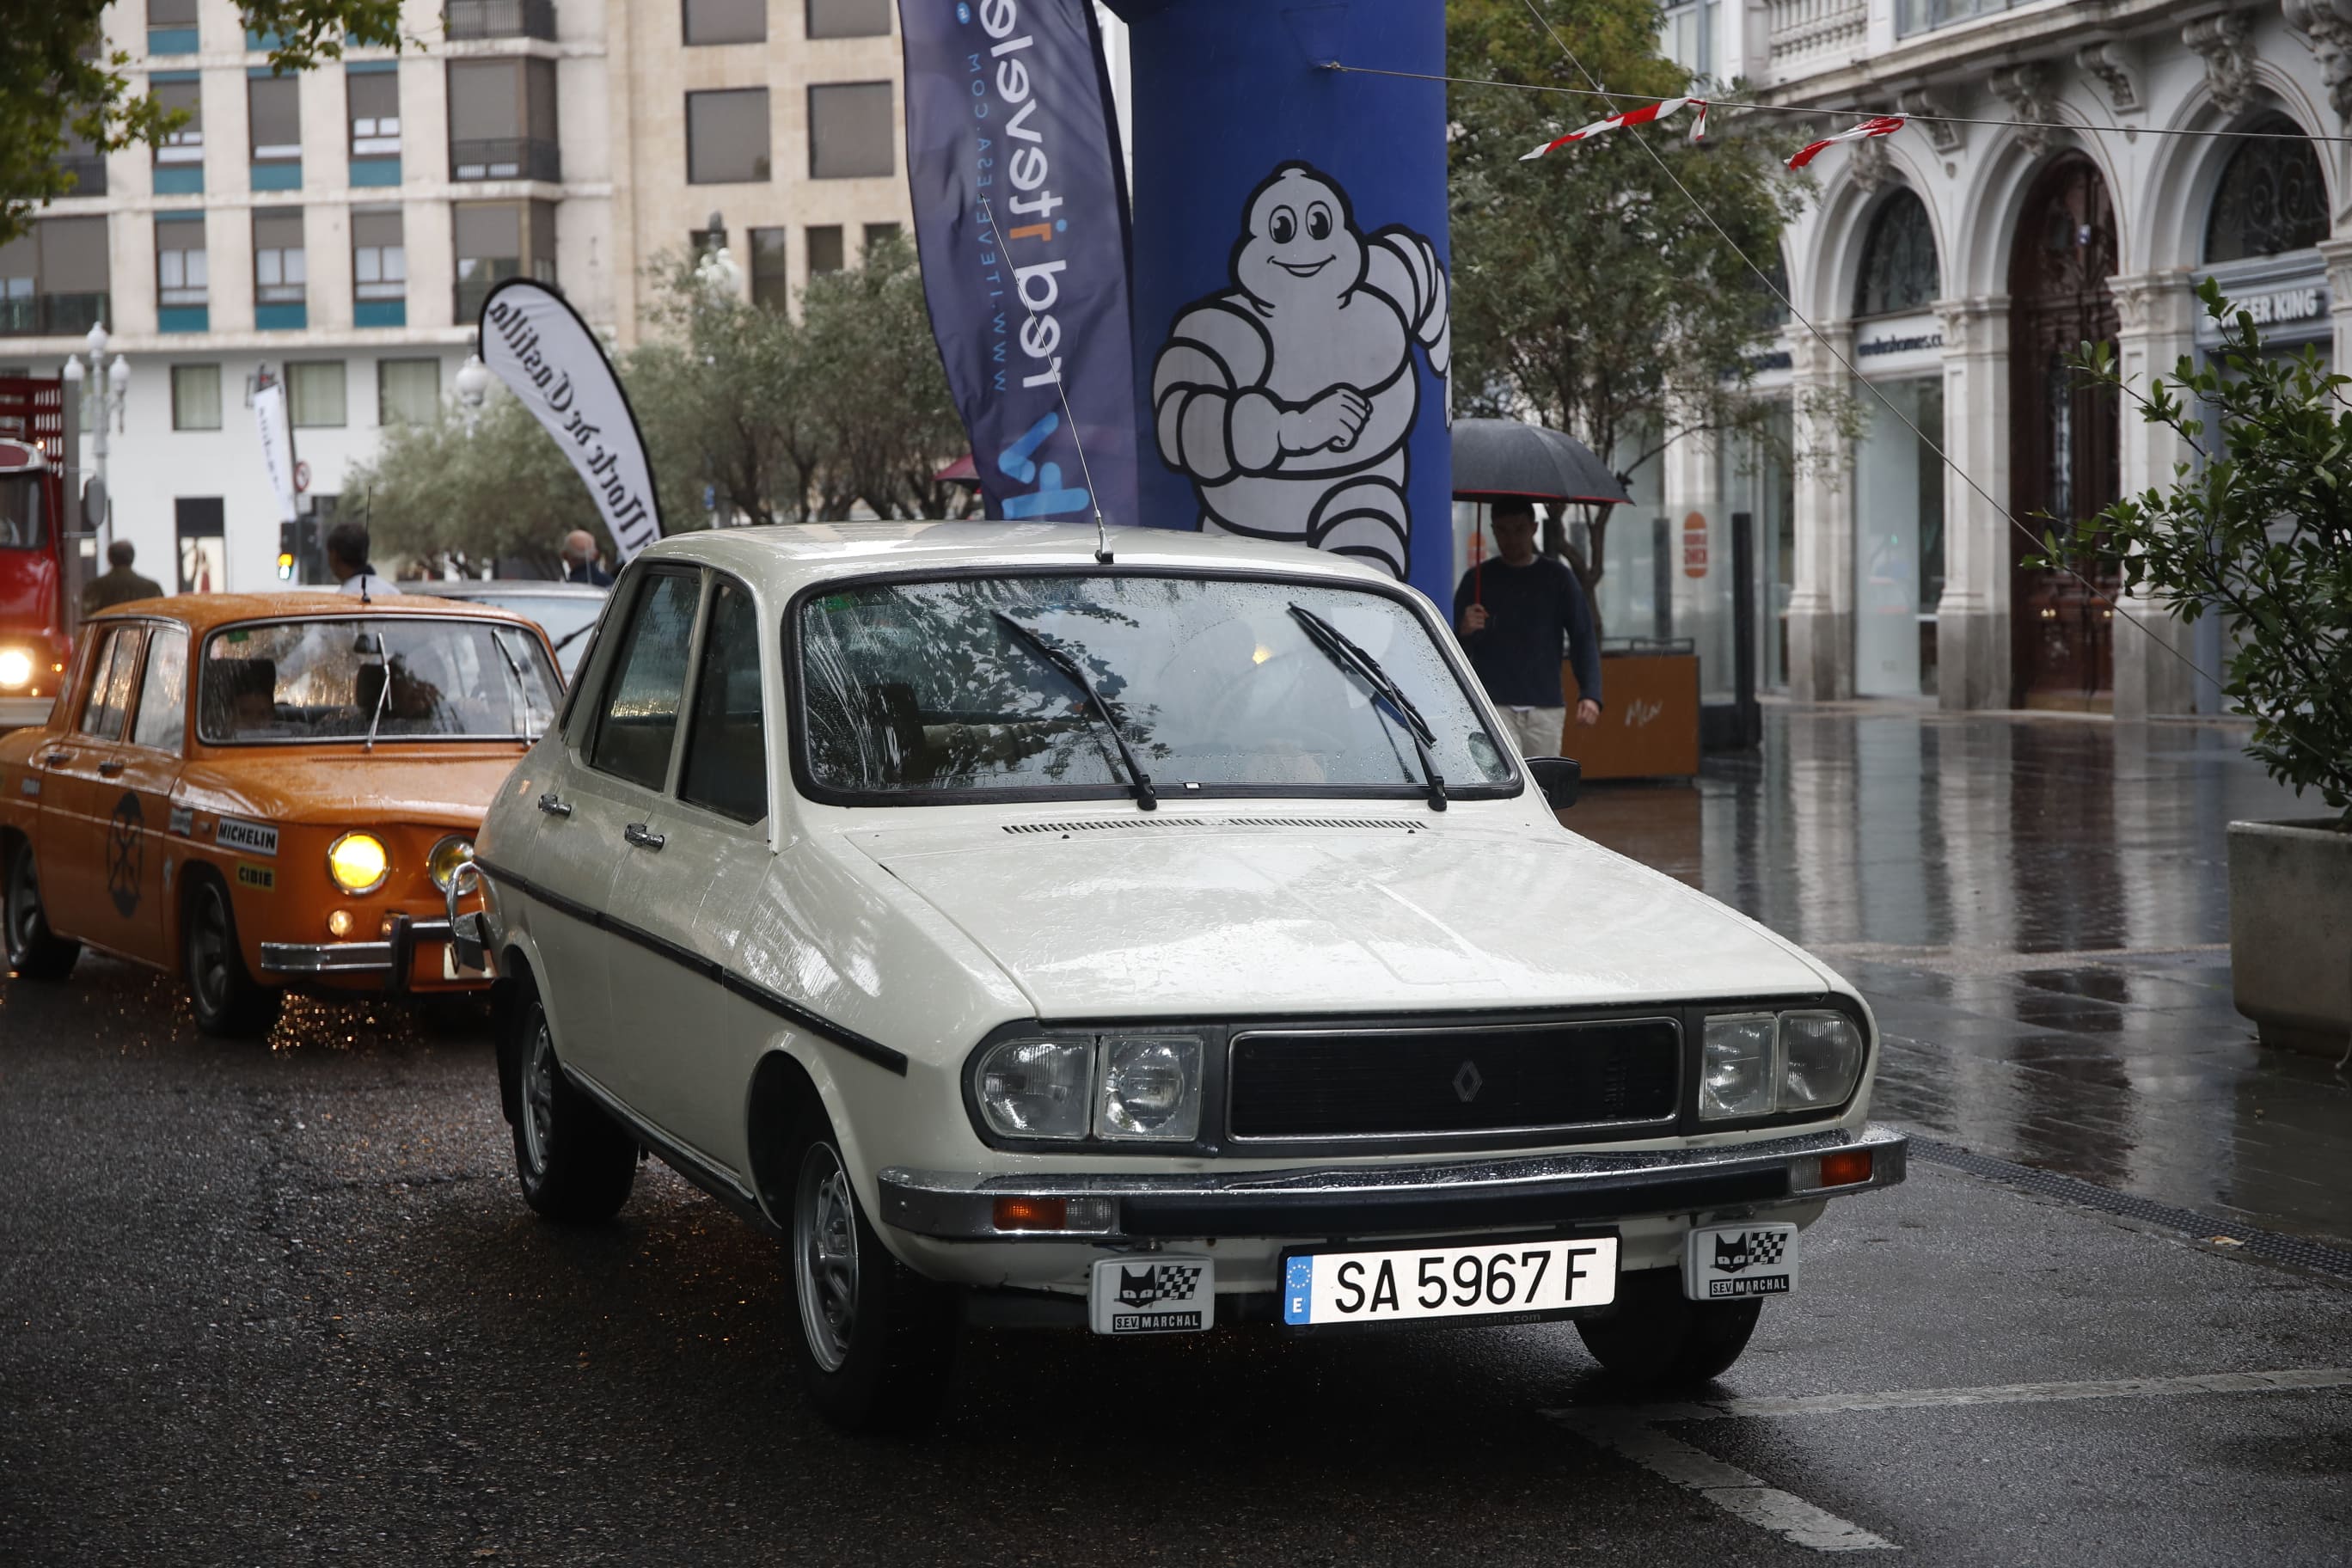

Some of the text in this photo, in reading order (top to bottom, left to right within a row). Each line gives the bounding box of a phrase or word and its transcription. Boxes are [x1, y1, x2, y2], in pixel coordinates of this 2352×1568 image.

[2274, 289, 2318, 321] KING
[218, 823, 276, 849] MICHELIN
[1335, 1247, 1597, 1314] SA 5967 F
[1736, 1278, 1787, 1293] MARCHAL
[1292, 1297, 1303, 1314] E
[1142, 1314, 1199, 1328] MARCHAL
